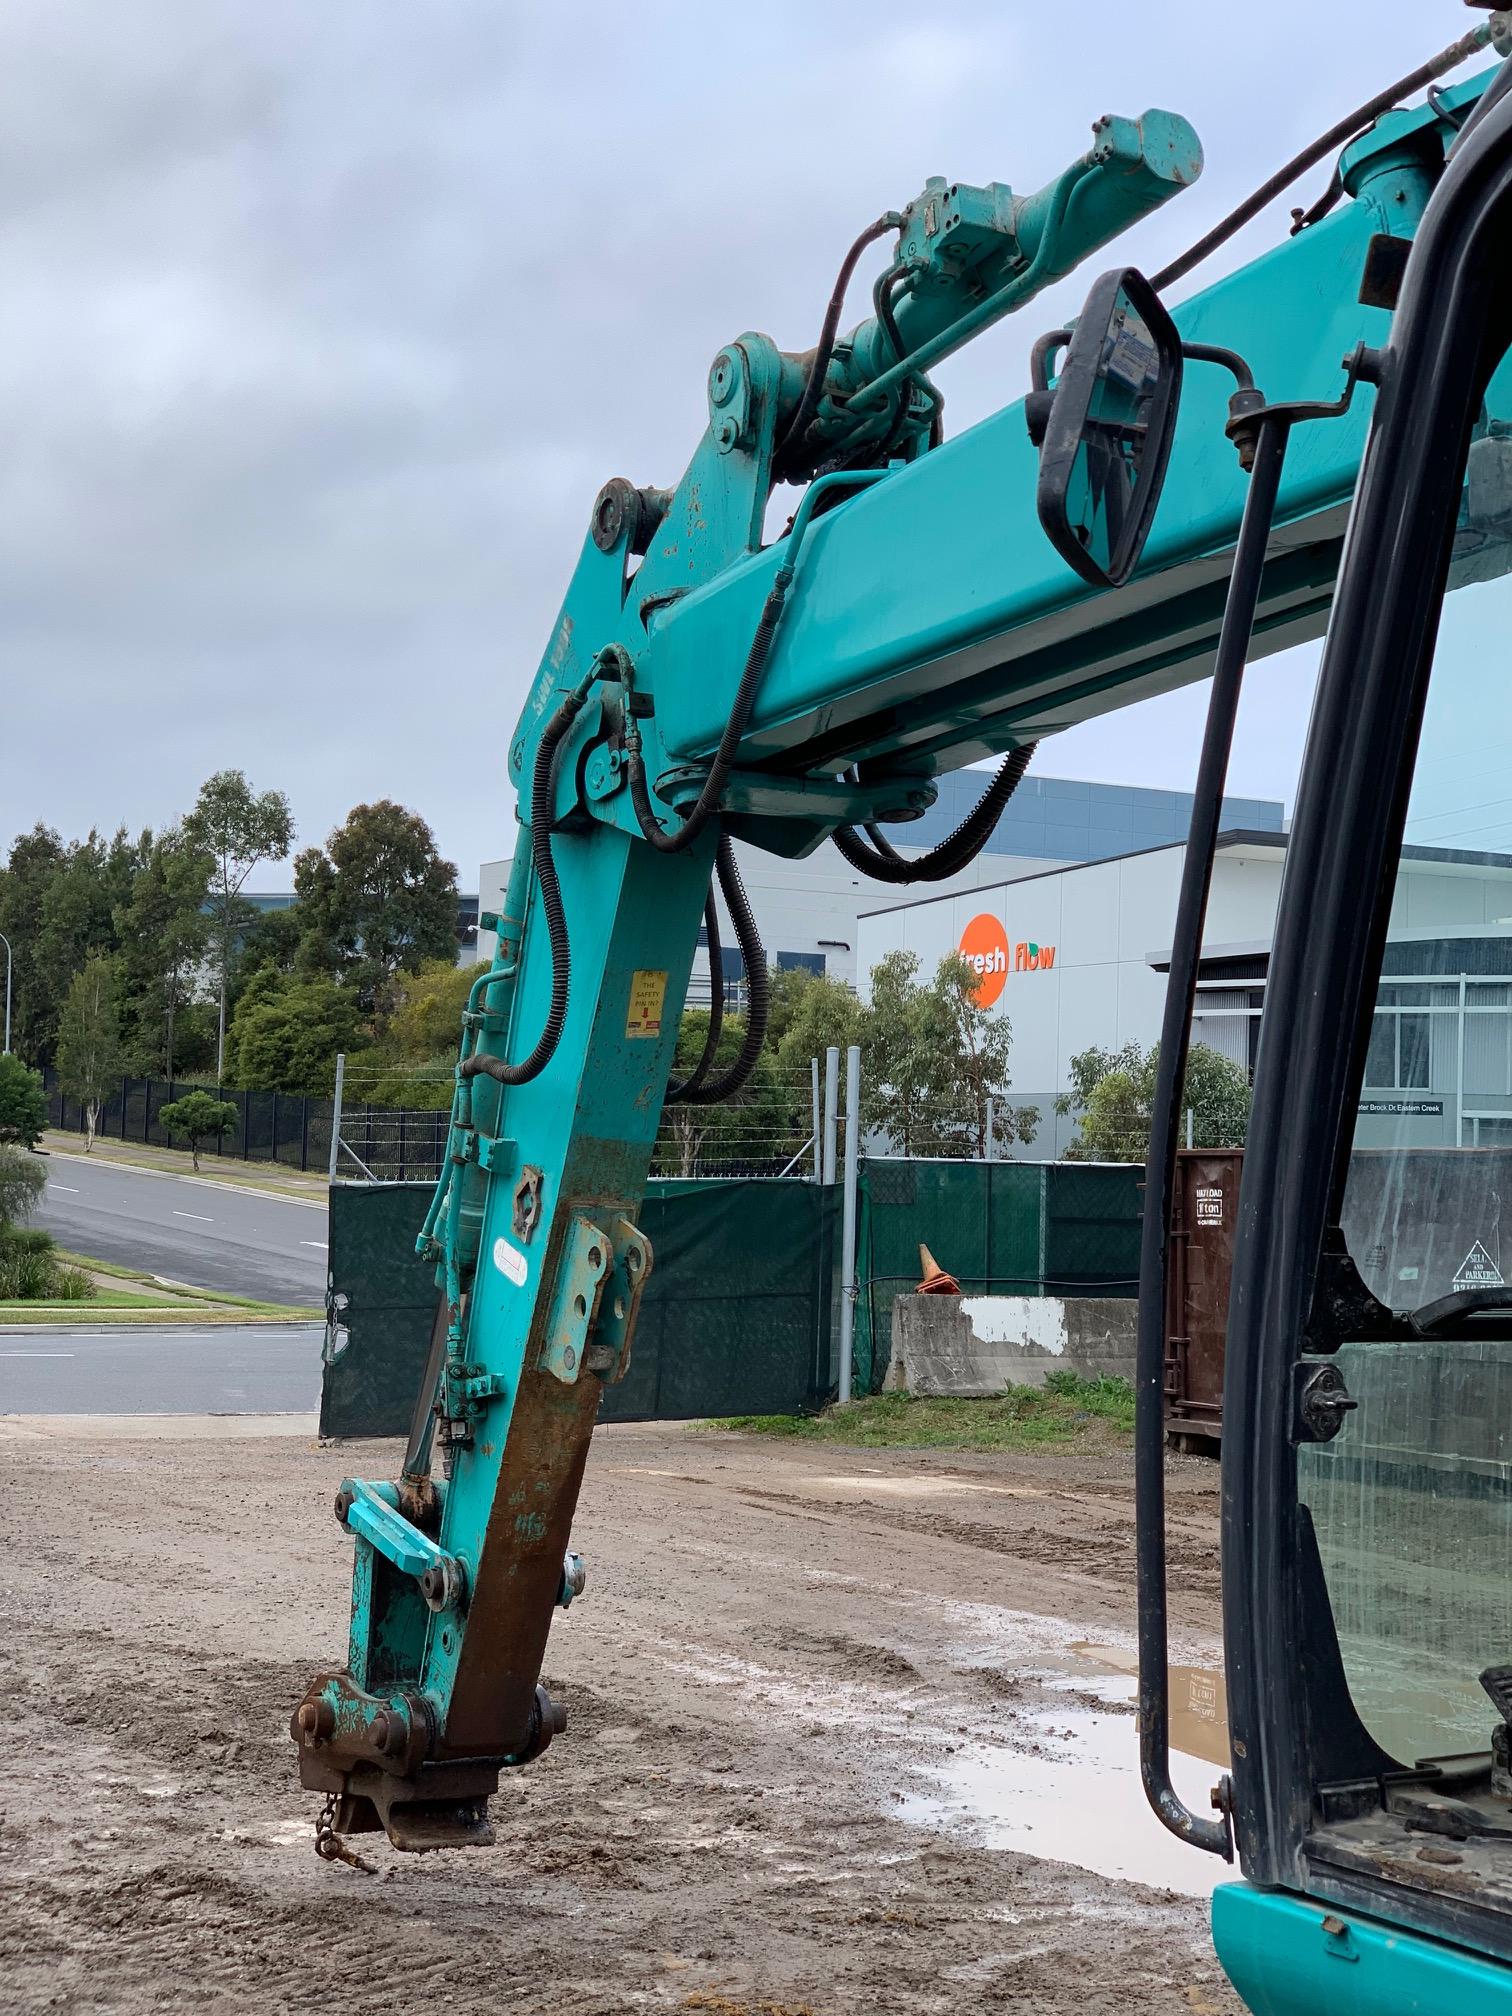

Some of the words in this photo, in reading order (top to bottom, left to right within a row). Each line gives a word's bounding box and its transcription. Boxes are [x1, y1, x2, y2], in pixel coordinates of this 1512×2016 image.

[1015, 942, 1056, 971] flow
[1370, 1103, 1388, 1112] Brock
[1421, 1104, 1440, 1112] Creek
